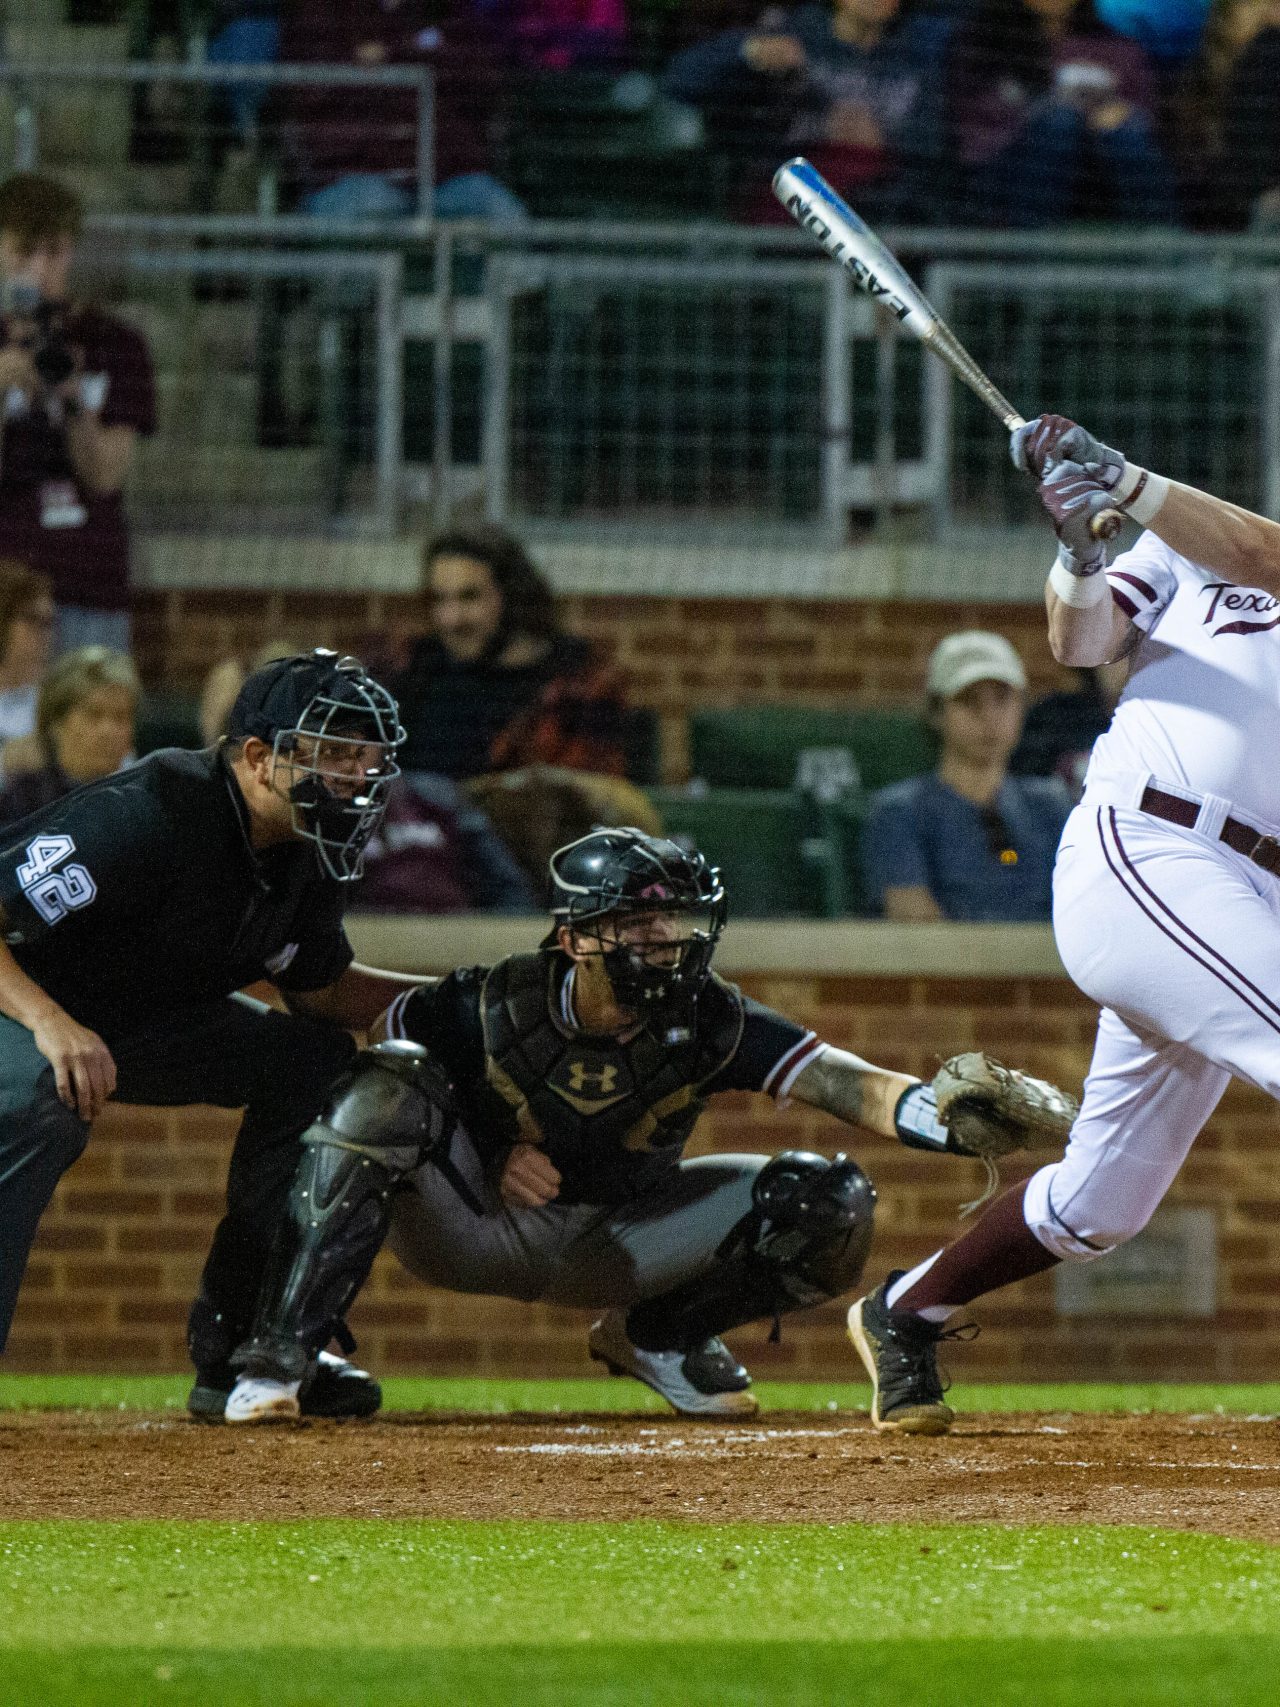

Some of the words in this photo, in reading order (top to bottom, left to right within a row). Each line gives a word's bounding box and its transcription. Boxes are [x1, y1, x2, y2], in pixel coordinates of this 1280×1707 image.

[785, 194, 913, 321] EASTON
[1198, 582, 1280, 625] Texa
[15, 834, 97, 926] 42
